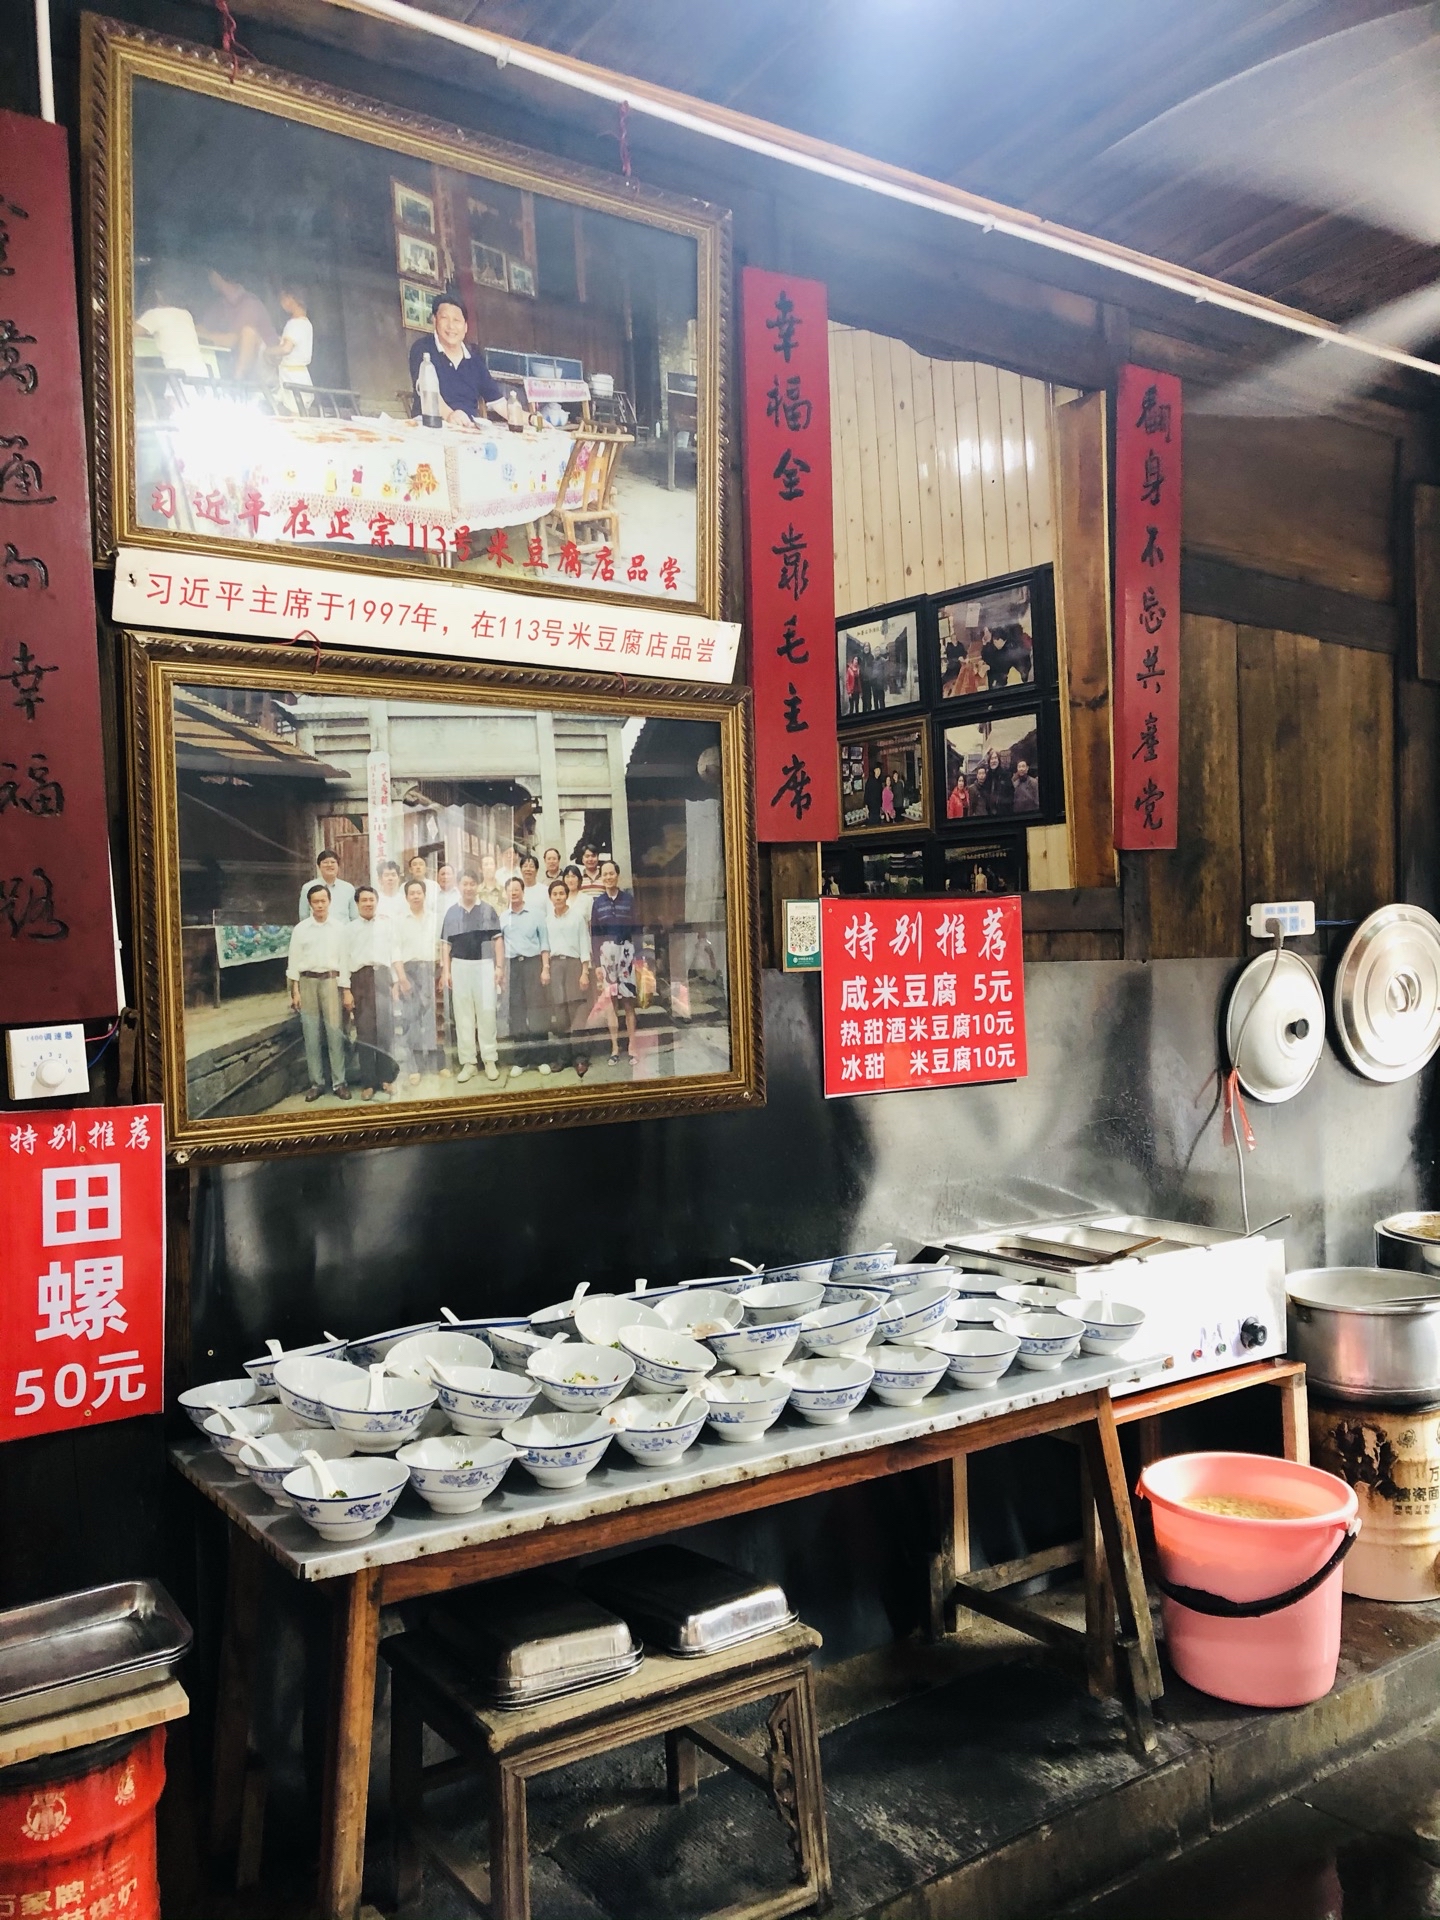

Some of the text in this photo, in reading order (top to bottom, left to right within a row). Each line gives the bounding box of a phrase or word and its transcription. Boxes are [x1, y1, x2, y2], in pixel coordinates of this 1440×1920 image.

[152, 482, 681, 590] 习近平在正宗113号米豆腐店品尝
[766, 290, 813, 820] 幸福全靠毛主席
[844, 907, 1007, 963] 特别推荐
[840, 970, 1013, 1011] 咸米豆腐 5元
[840, 1010, 1015, 1047] 热甜酒米豆腐10元
[841, 1042, 1016, 1081] 冰甜 米豆腐10元
[10, 1115, 152, 1156] 特别推荐
[35, 1163, 128, 1343] 田螺
[15, 1349, 147, 1416] 50元
